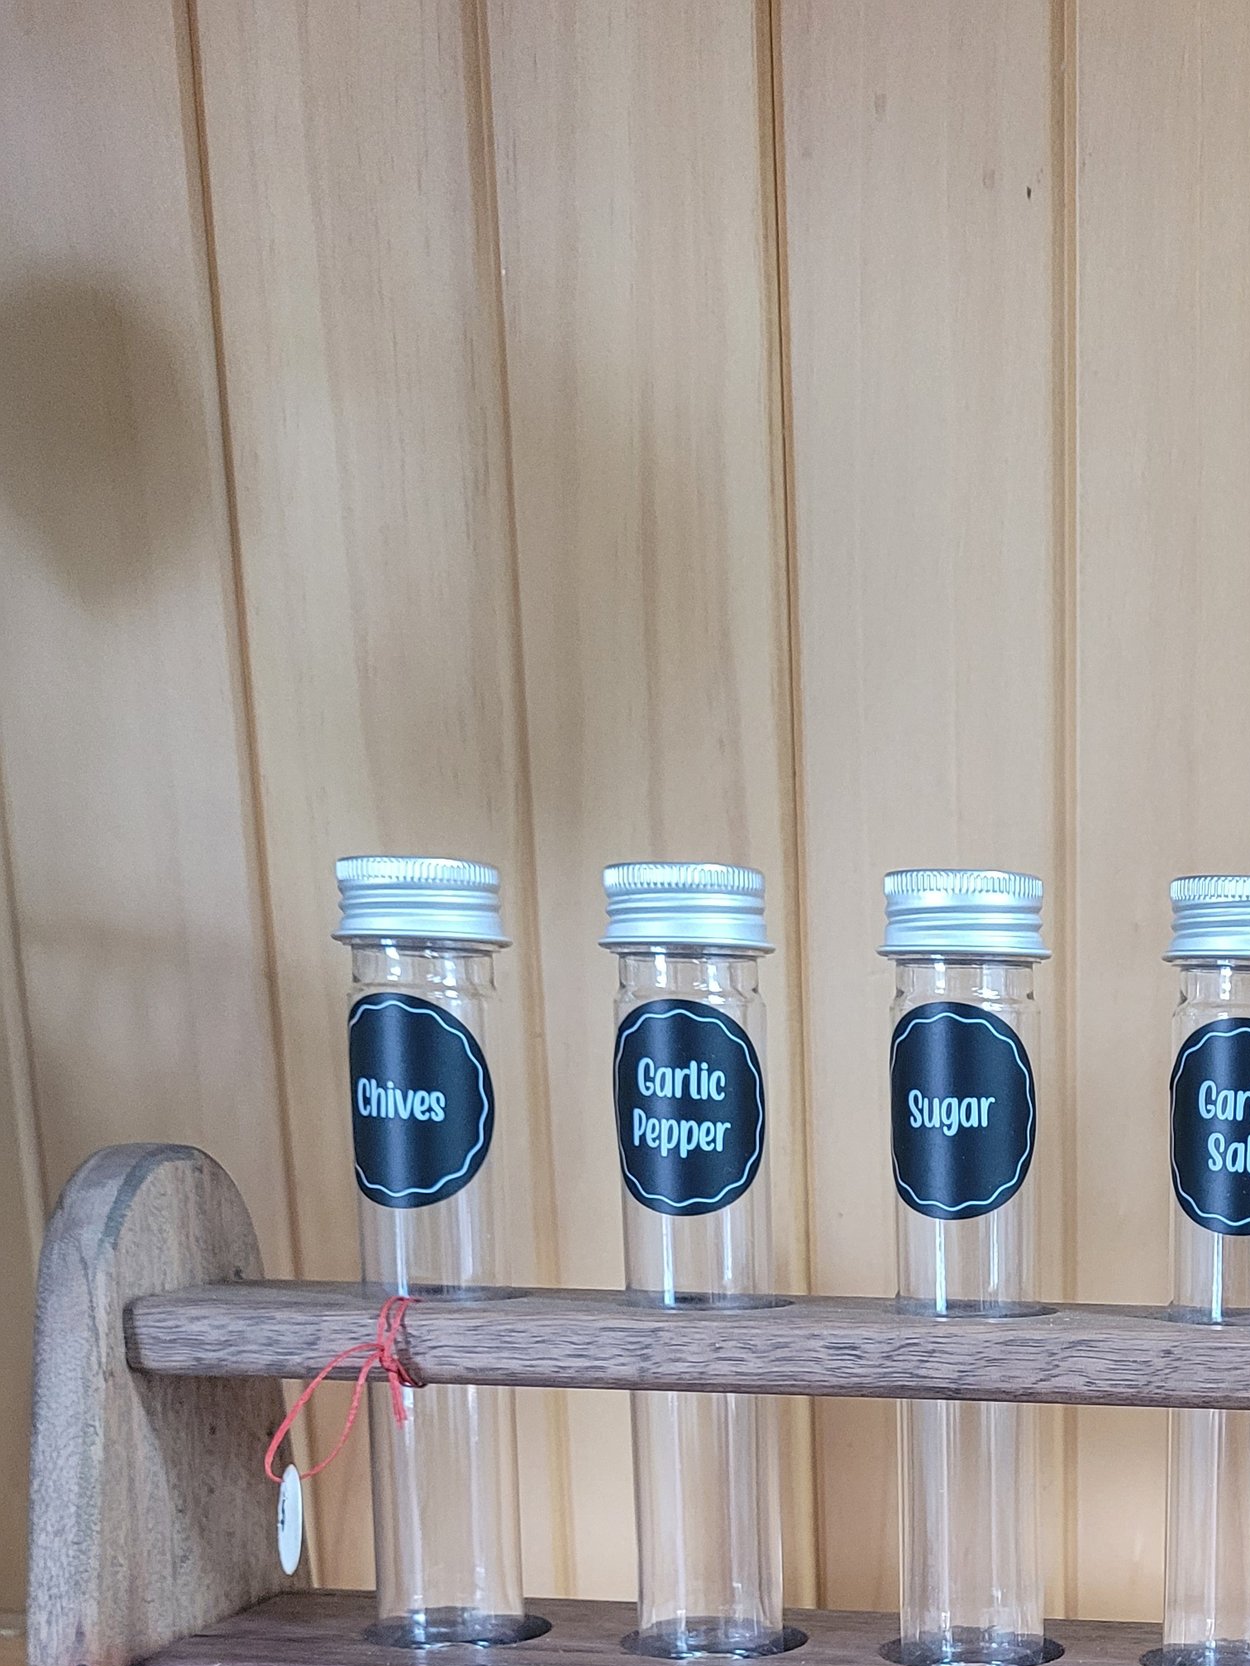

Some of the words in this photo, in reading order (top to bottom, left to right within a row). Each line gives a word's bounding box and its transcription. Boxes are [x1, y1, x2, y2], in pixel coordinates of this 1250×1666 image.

[357, 1077, 446, 1122] Chives
[636, 1057, 726, 1100] Garlic
[633, 1108, 731, 1158] Pepper
[908, 1089, 996, 1136] Sugar
